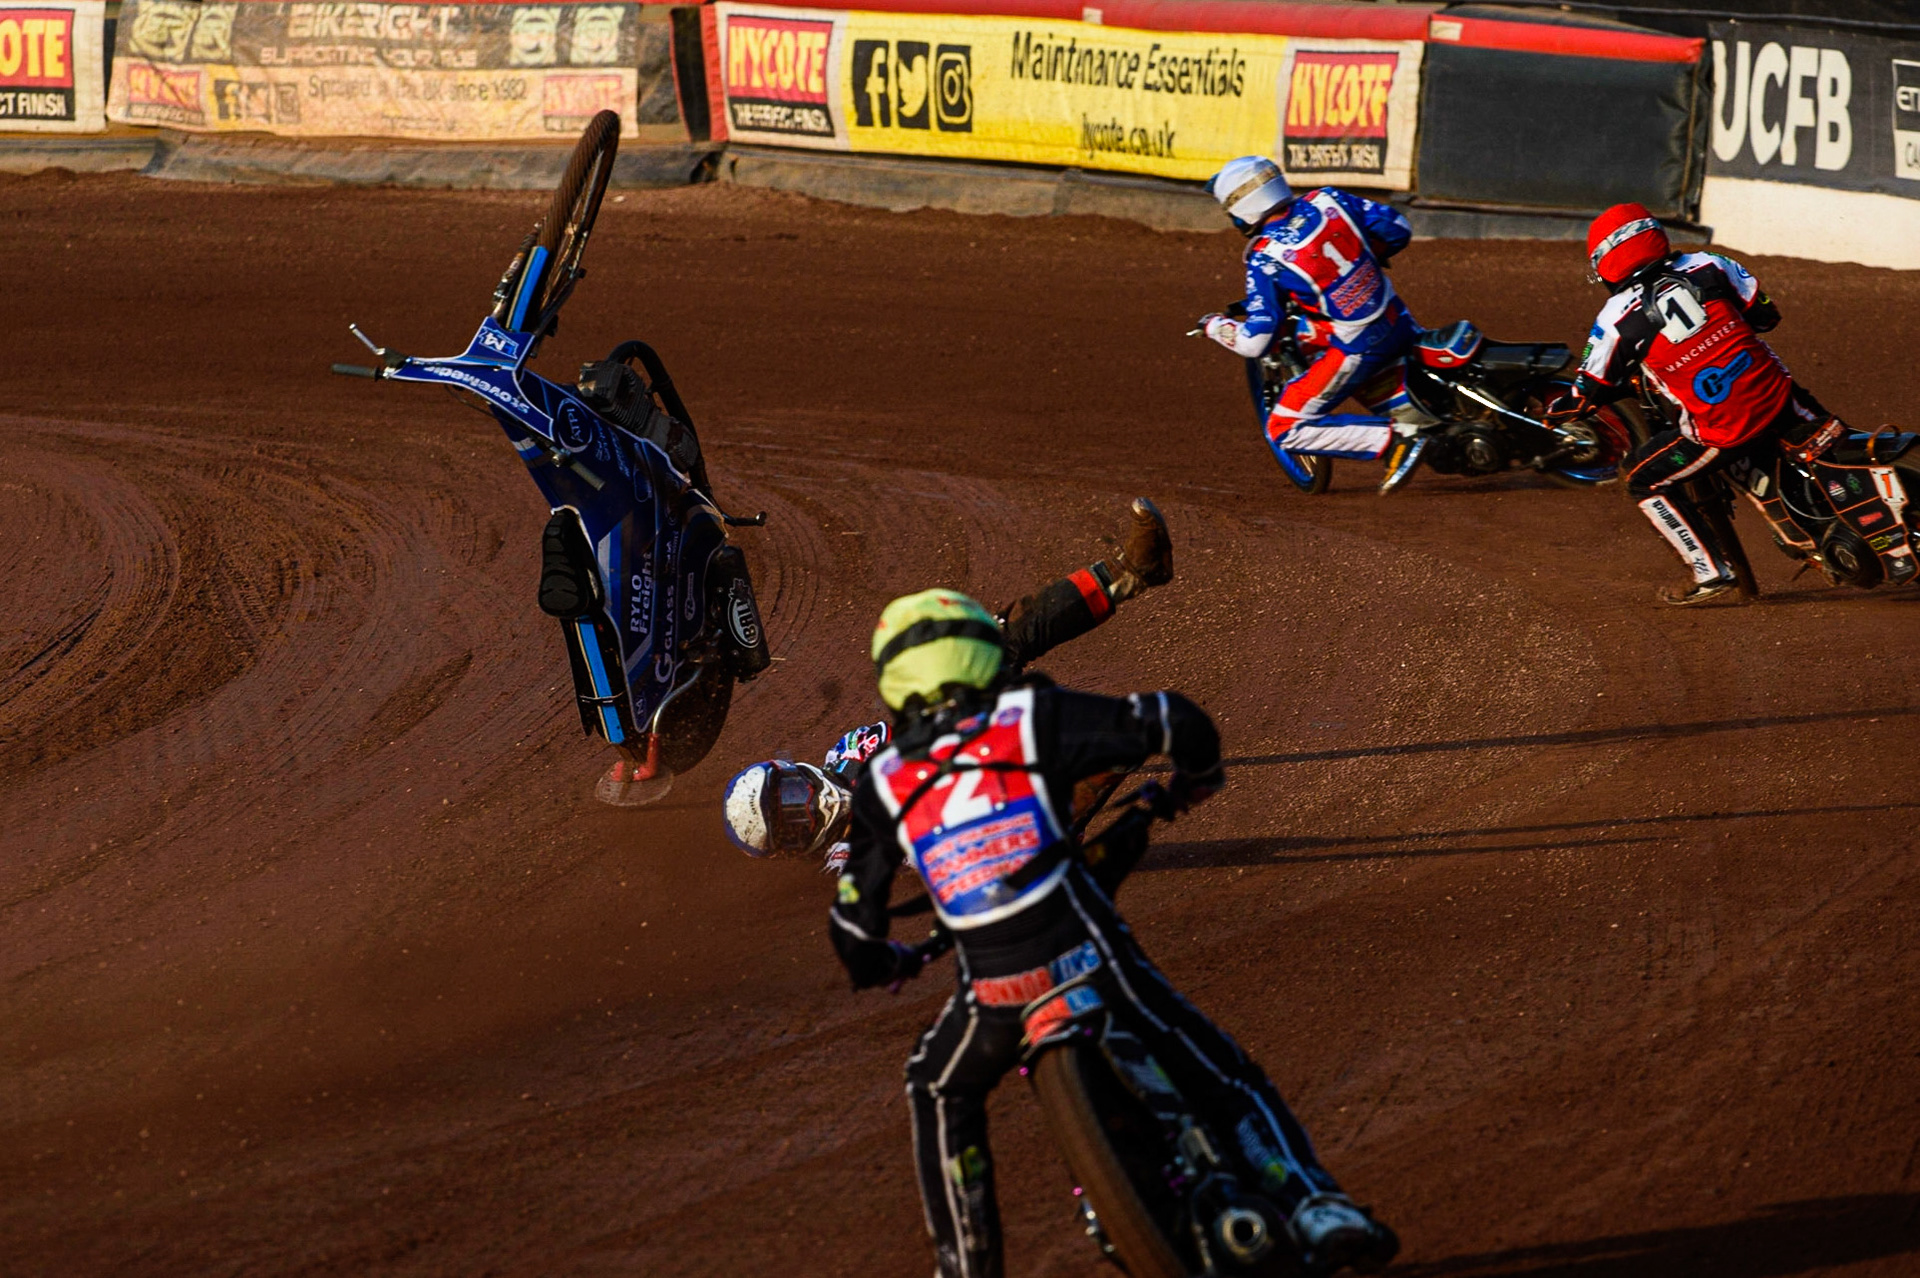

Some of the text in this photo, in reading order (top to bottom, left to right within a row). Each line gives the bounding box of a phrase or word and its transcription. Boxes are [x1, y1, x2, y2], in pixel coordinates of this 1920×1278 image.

[728, 26, 828, 94] HYCOTE
[1143, 43, 1246, 97] Essentials
[1287, 62, 1393, 128] HYCOTE
[1712, 40, 1852, 171] UCFB
[1322, 241, 1355, 277] 1
[1666, 296, 1696, 330] 1
[1665, 321, 1736, 372] MANCHESTER
[630, 575, 643, 633] RYLO
[638, 552, 654, 634] Freight
[933, 752, 994, 830] 2
